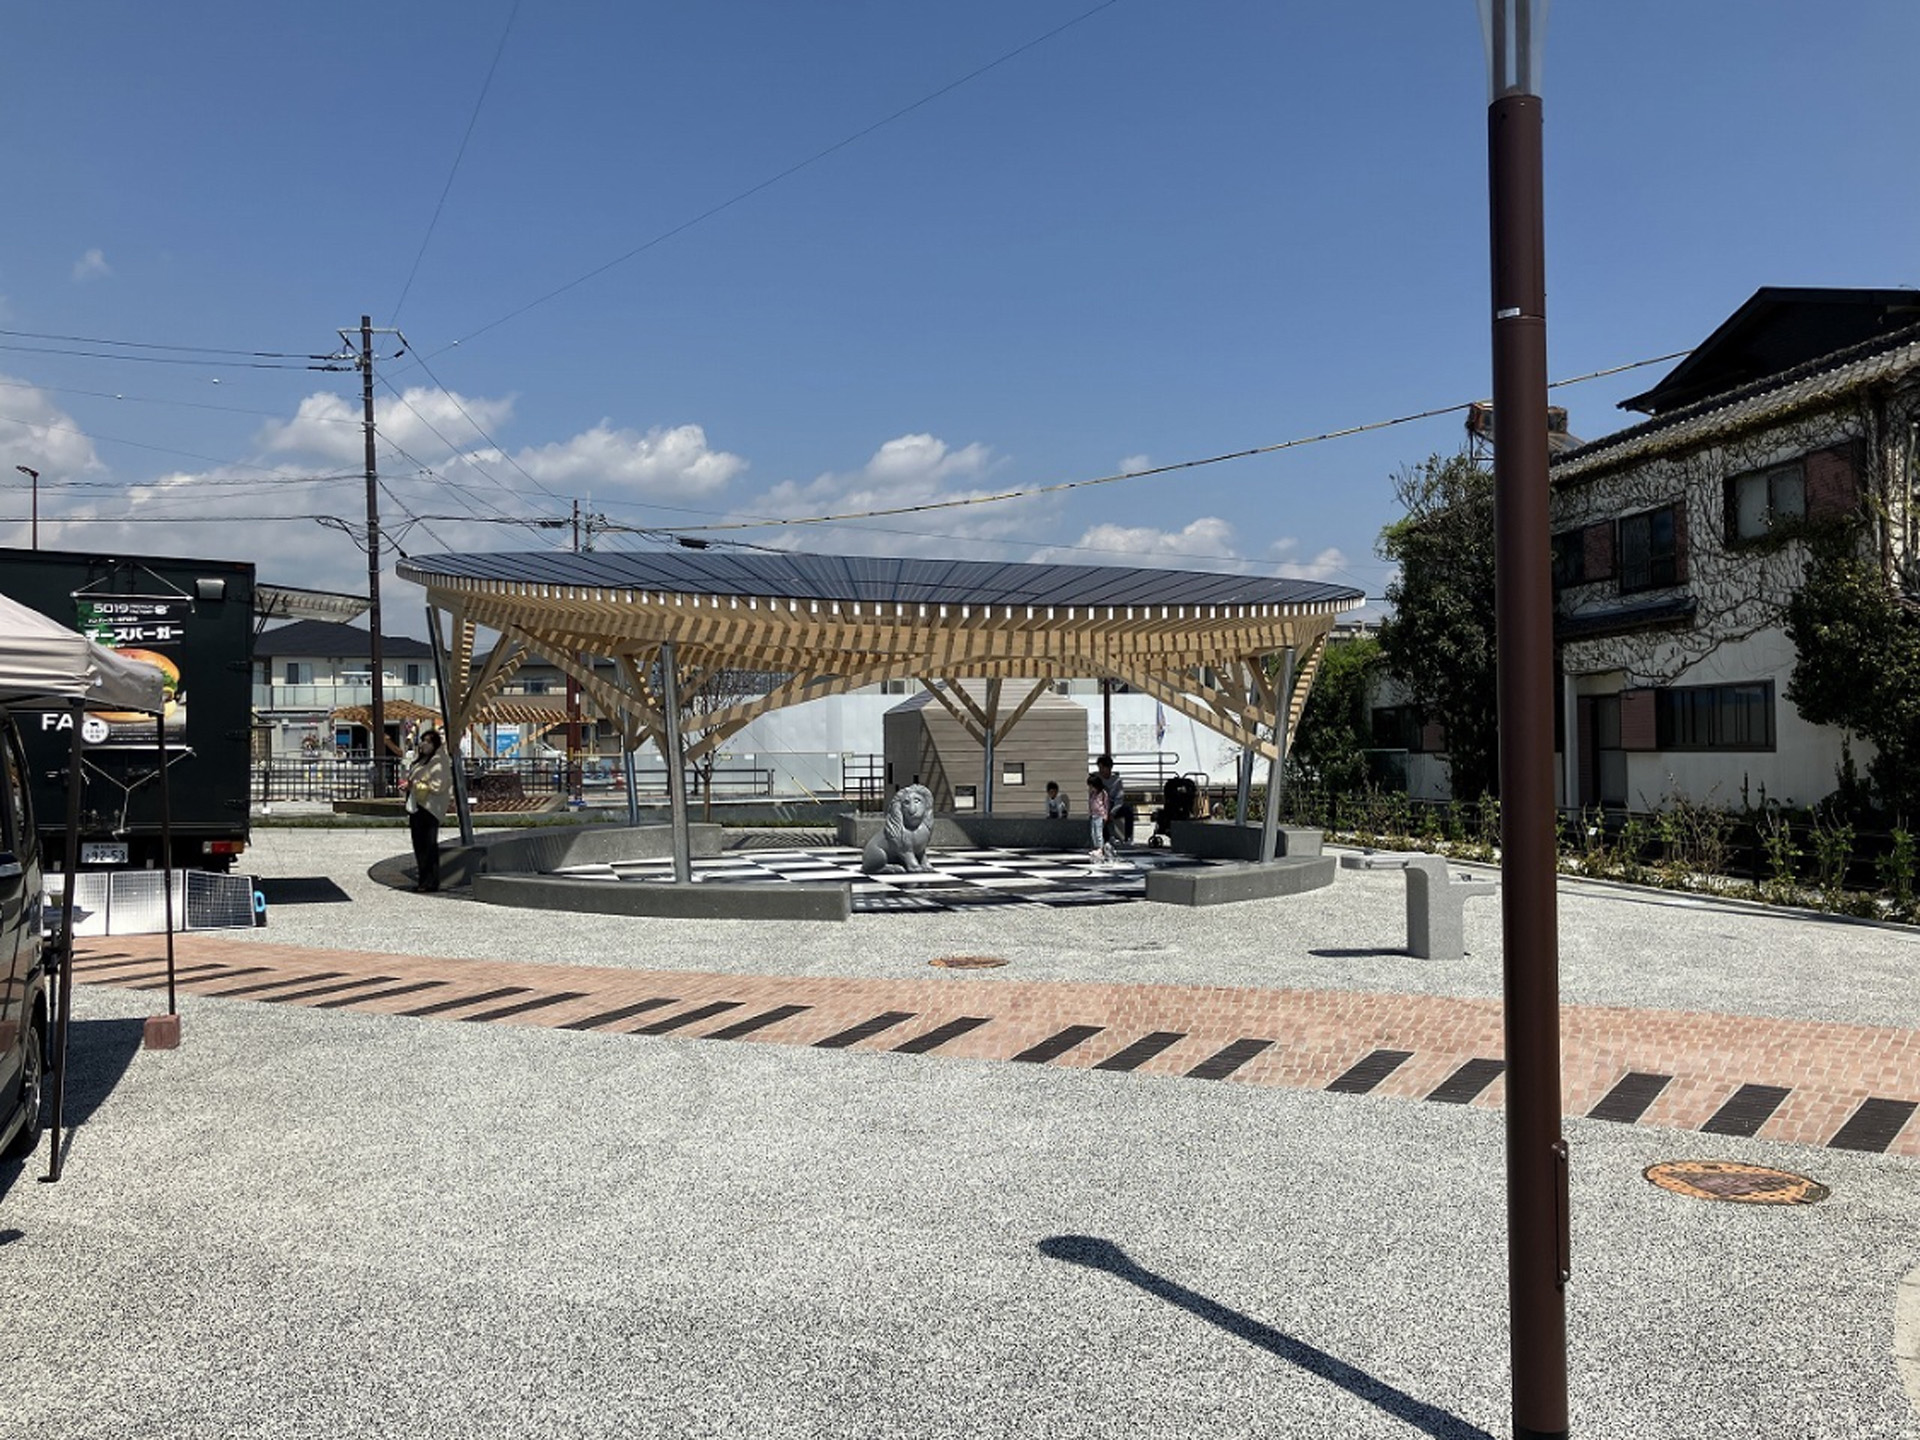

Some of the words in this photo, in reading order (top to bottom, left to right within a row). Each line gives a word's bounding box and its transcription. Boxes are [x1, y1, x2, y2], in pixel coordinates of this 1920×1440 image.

[85, 626, 184, 641] チーズバーガー
